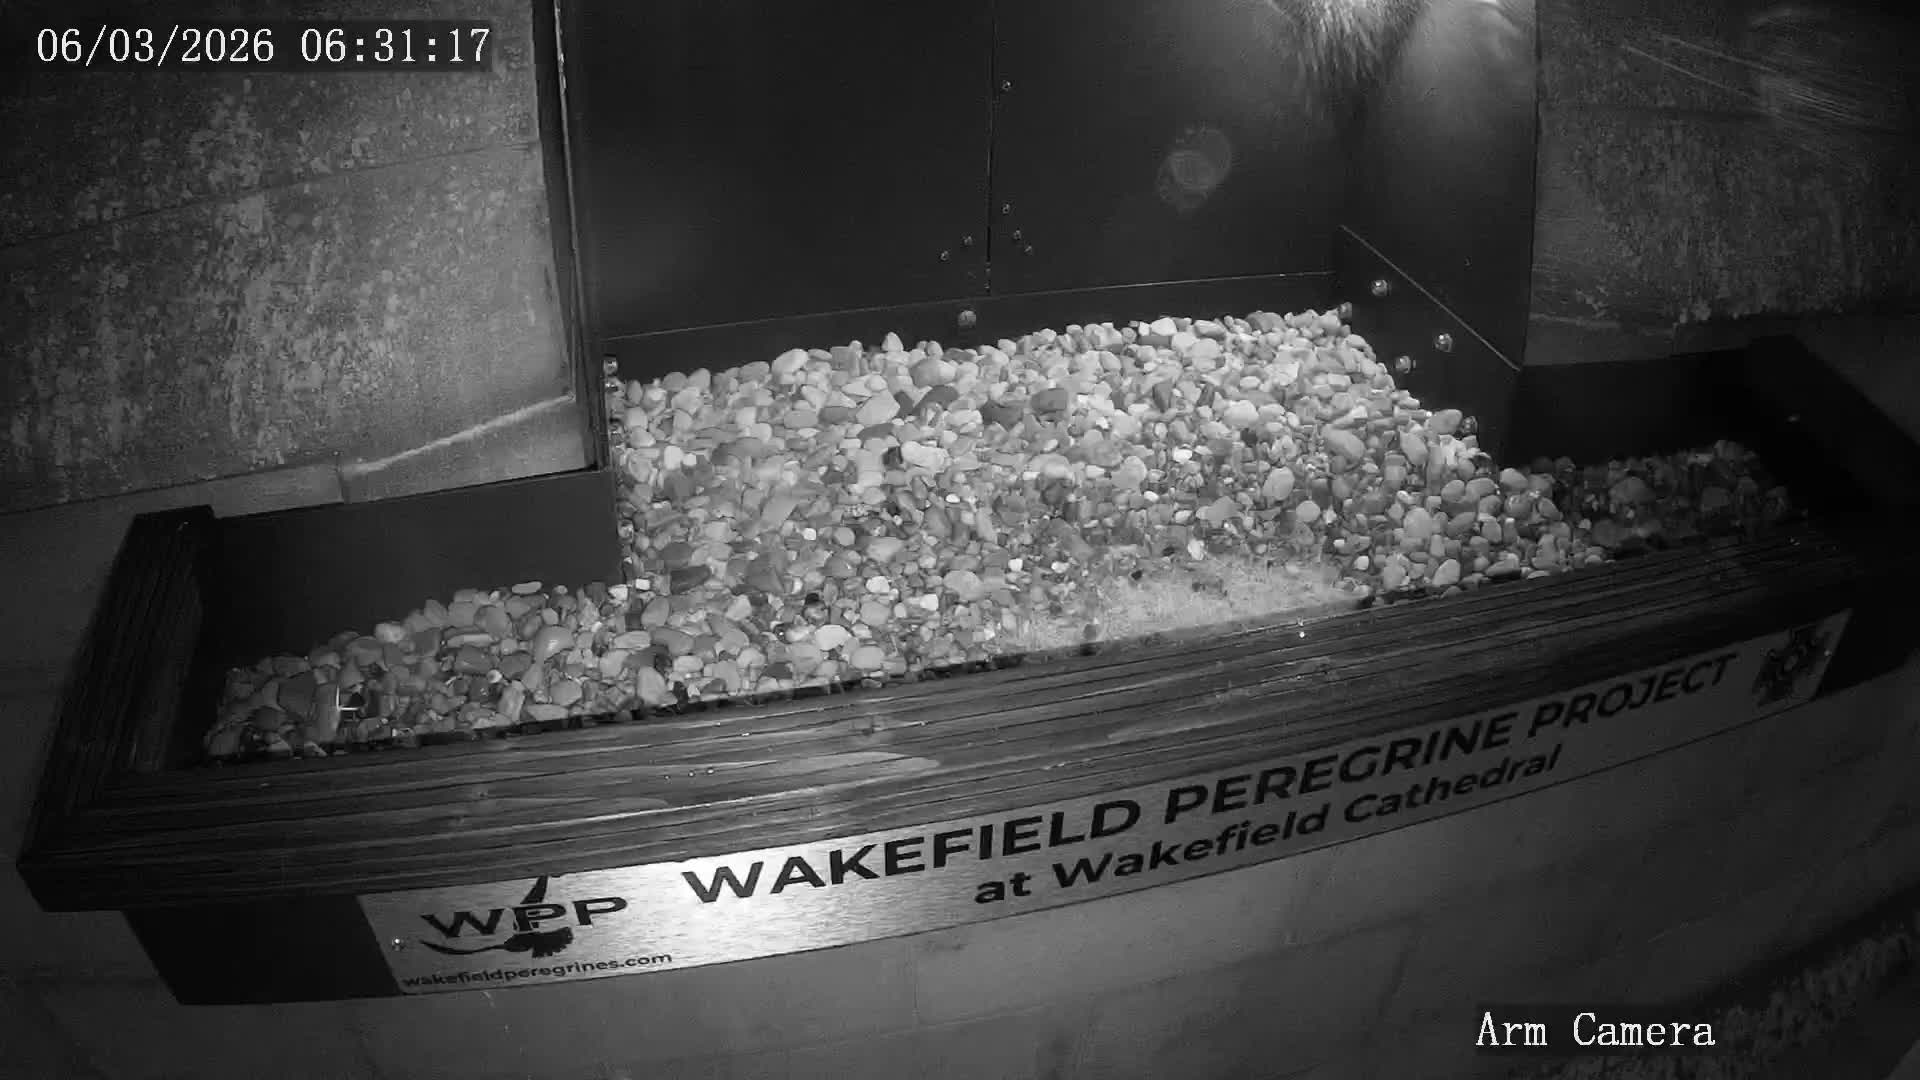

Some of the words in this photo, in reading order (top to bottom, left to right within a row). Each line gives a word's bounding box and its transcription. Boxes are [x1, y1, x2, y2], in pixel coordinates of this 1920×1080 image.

[682, 799, 1141, 903] WAKEFIELD
[1164, 713, 1517, 824] PEREGRINE
[1527, 652, 1739, 740] PROJECT
[974, 871, 1033, 904] at
[1052, 803, 1327, 888] Wakefield
[1344, 744, 1563, 824] Cathedral
[420, 896, 628, 938] WPP
[402, 952, 673, 988] wakefieldperegrines.com
